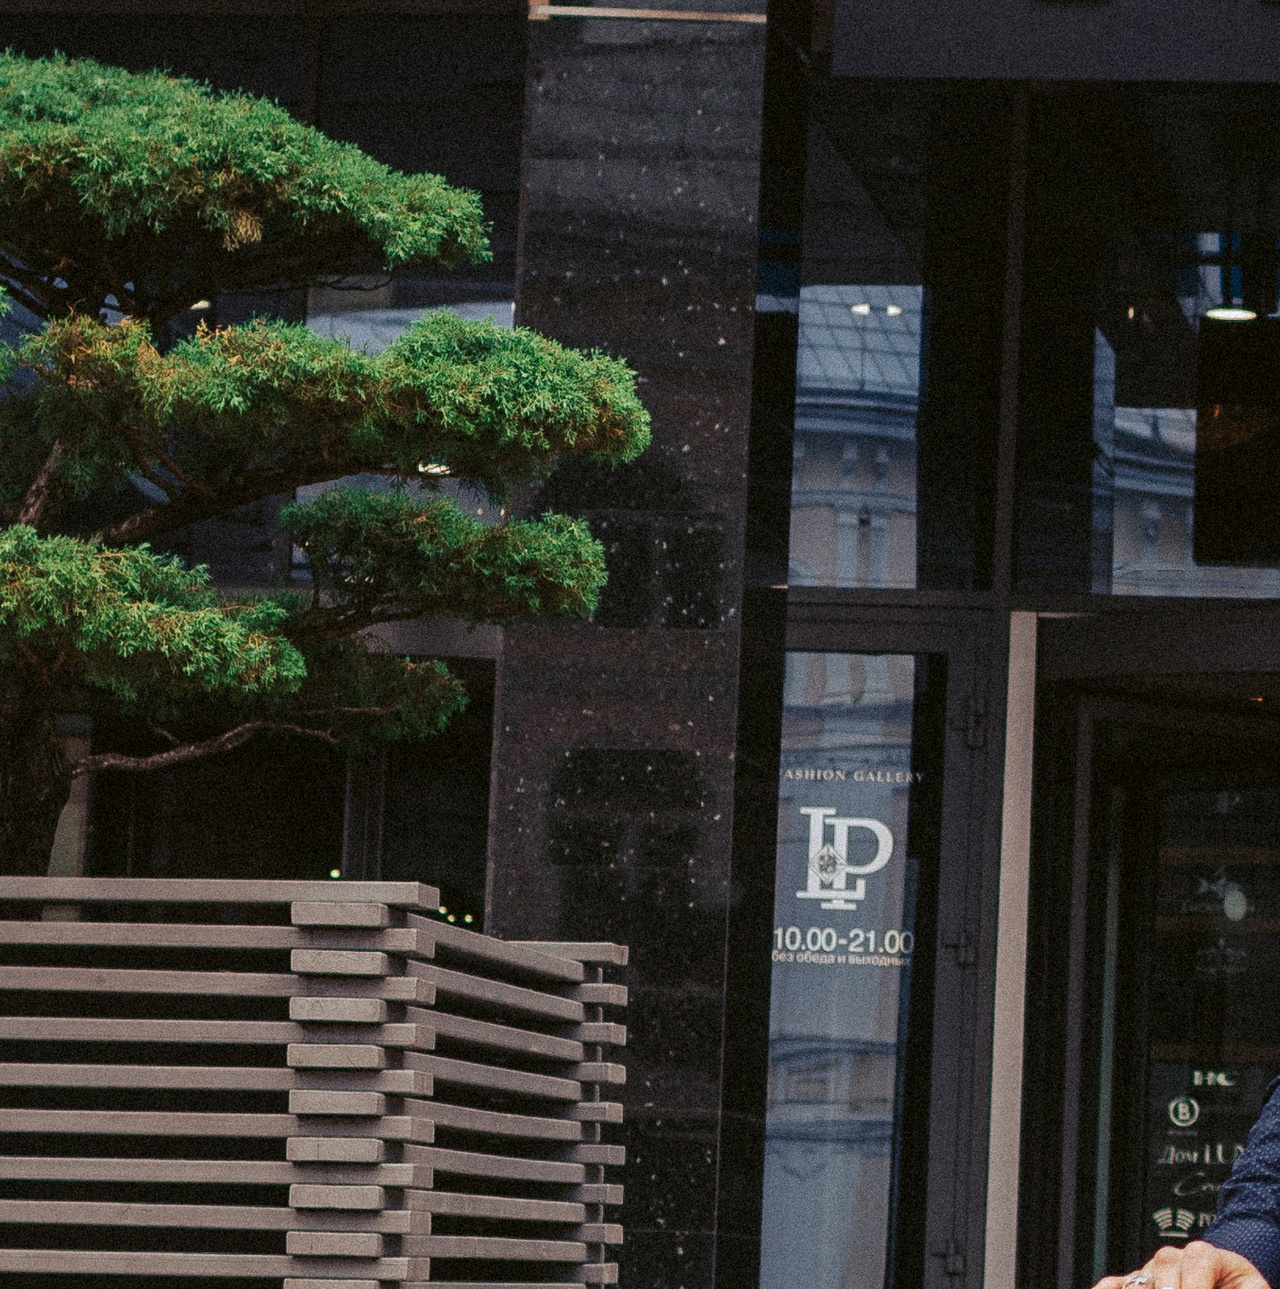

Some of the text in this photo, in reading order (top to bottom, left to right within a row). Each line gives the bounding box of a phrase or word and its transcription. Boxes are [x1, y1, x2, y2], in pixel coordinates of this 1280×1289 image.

[853, 769, 925, 783] GALLERY
[772, 925, 915, 955] 10.00-21.00
[771, 949, 794, 962] без
[796, 951, 835, 965] обеда
[837, 954, 846, 964] и
